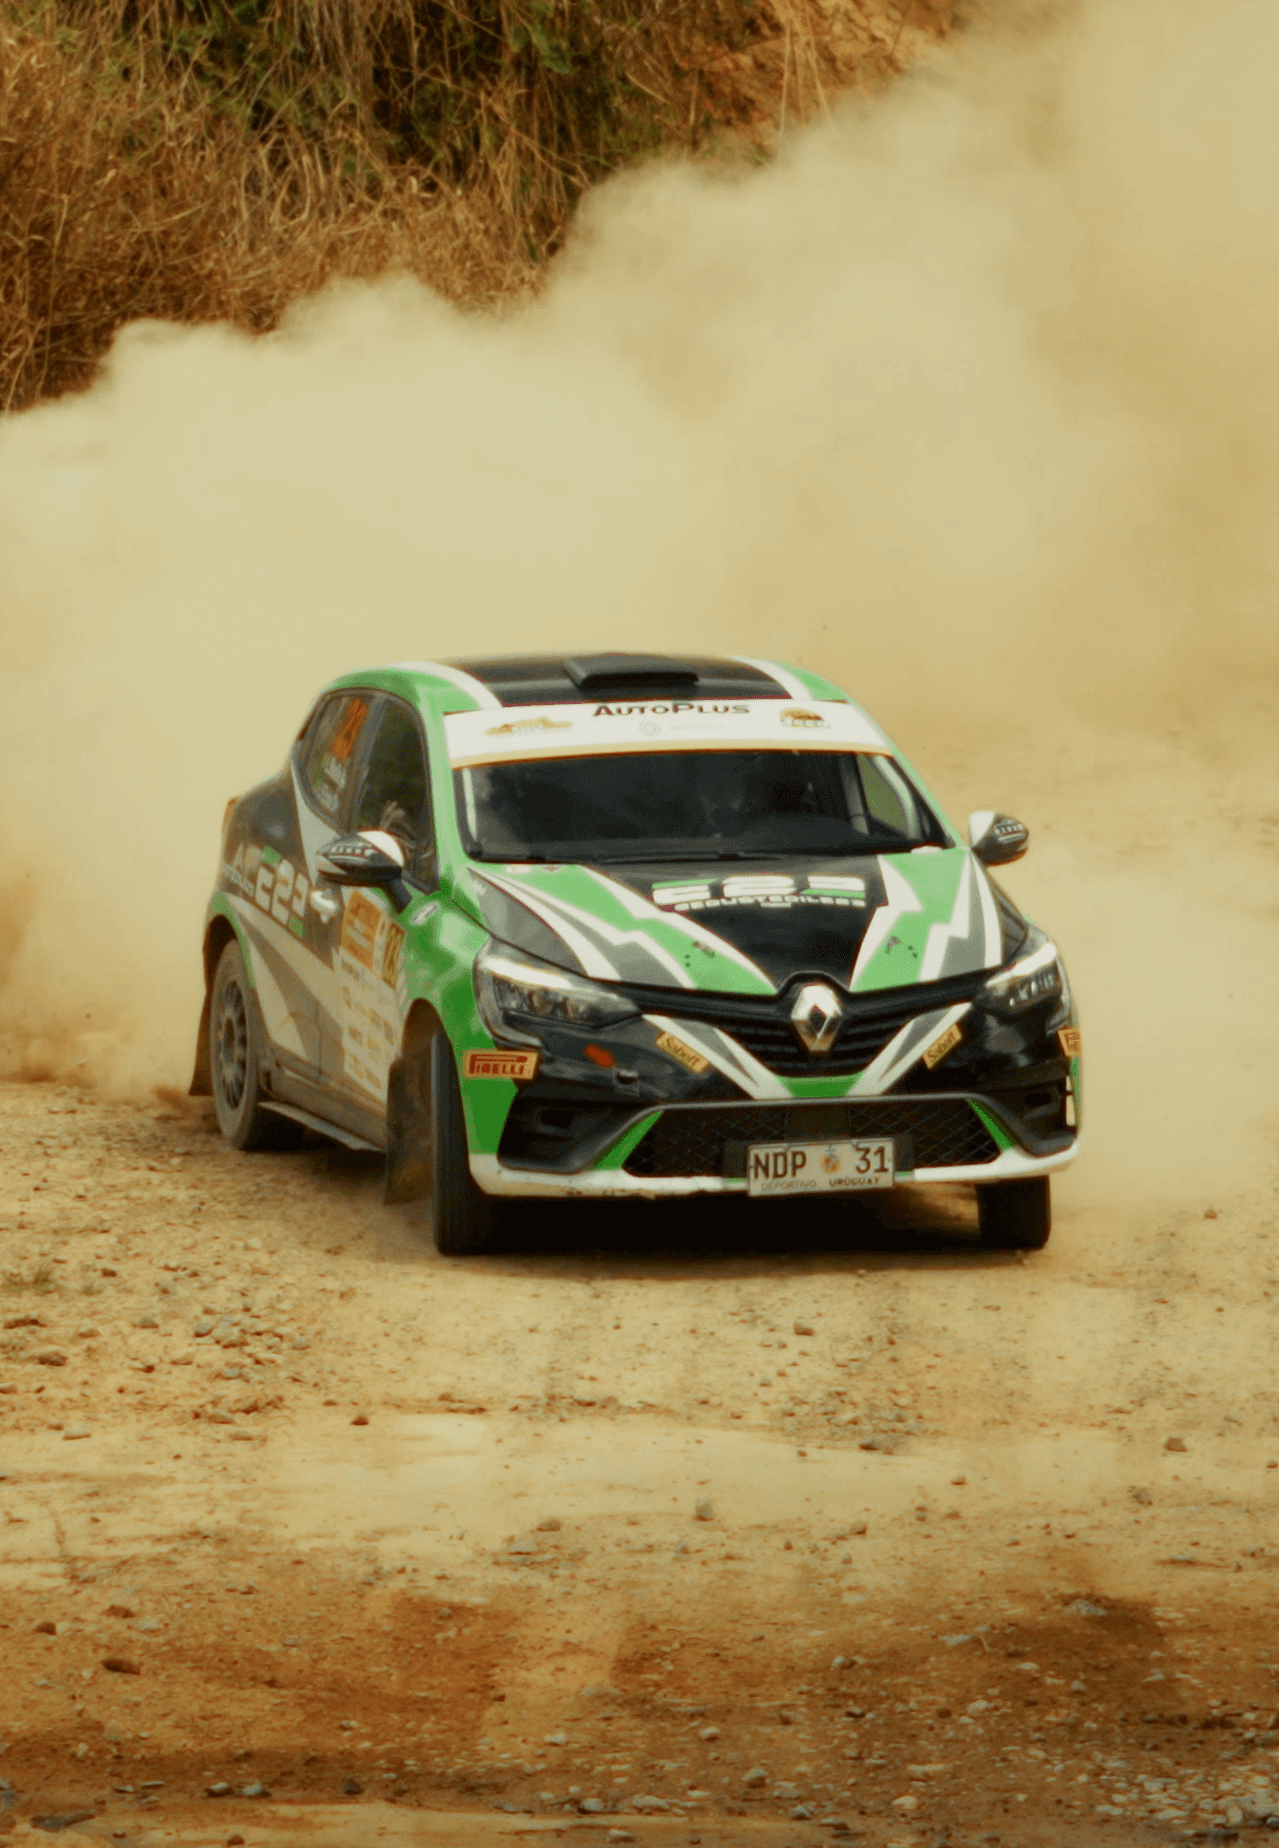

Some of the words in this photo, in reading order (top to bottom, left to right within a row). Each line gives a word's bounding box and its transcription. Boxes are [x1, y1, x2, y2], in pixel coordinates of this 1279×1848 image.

[468, 1054, 528, 1074] PIRELLI
[753, 1150, 807, 1179] NDP
[854, 1146, 889, 1174] 31
[761, 1180, 817, 1190] DEPORTIVO
[829, 1177, 881, 1187] URUGUAY
